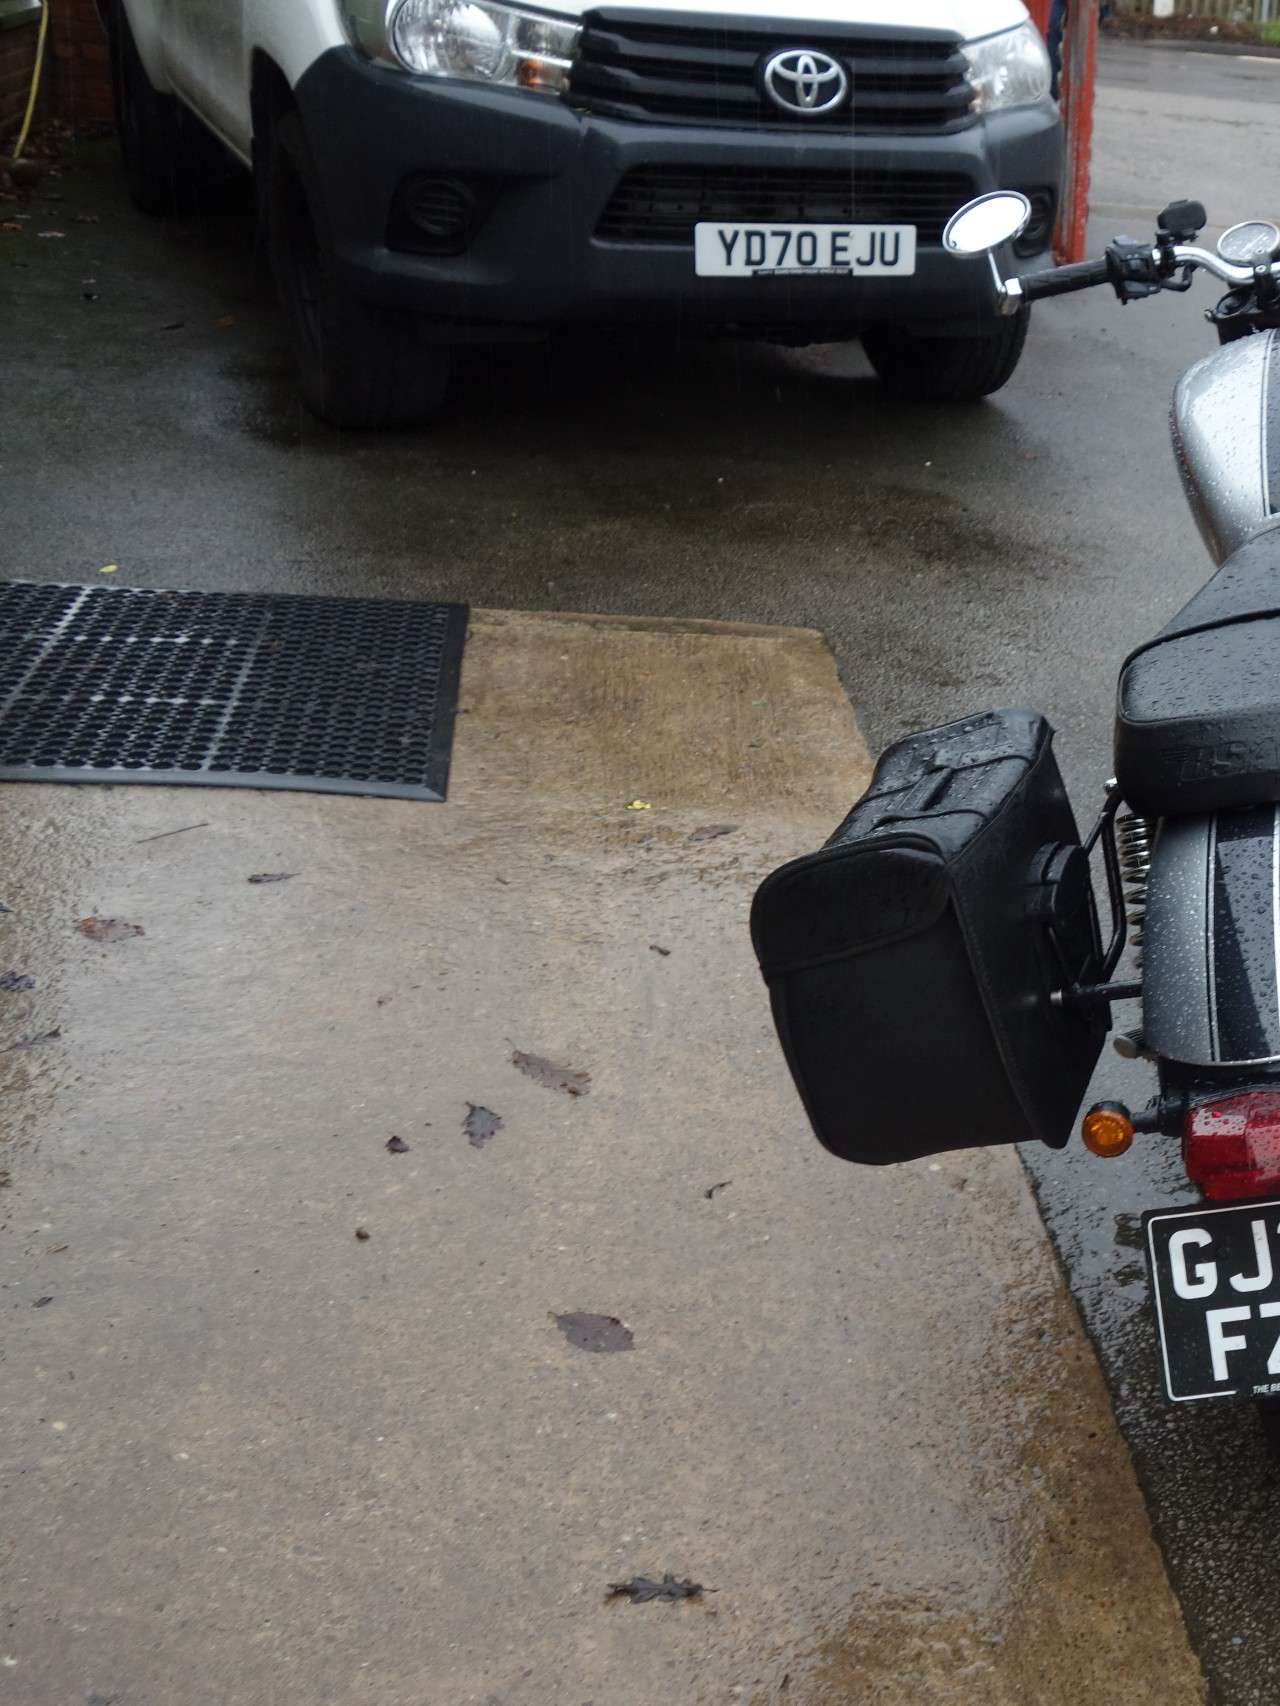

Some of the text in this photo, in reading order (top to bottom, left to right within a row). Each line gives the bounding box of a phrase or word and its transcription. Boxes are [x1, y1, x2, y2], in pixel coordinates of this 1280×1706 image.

[717, 229, 900, 267] YD70 EJU
[1253, 1384, 1270, 1394] THE
